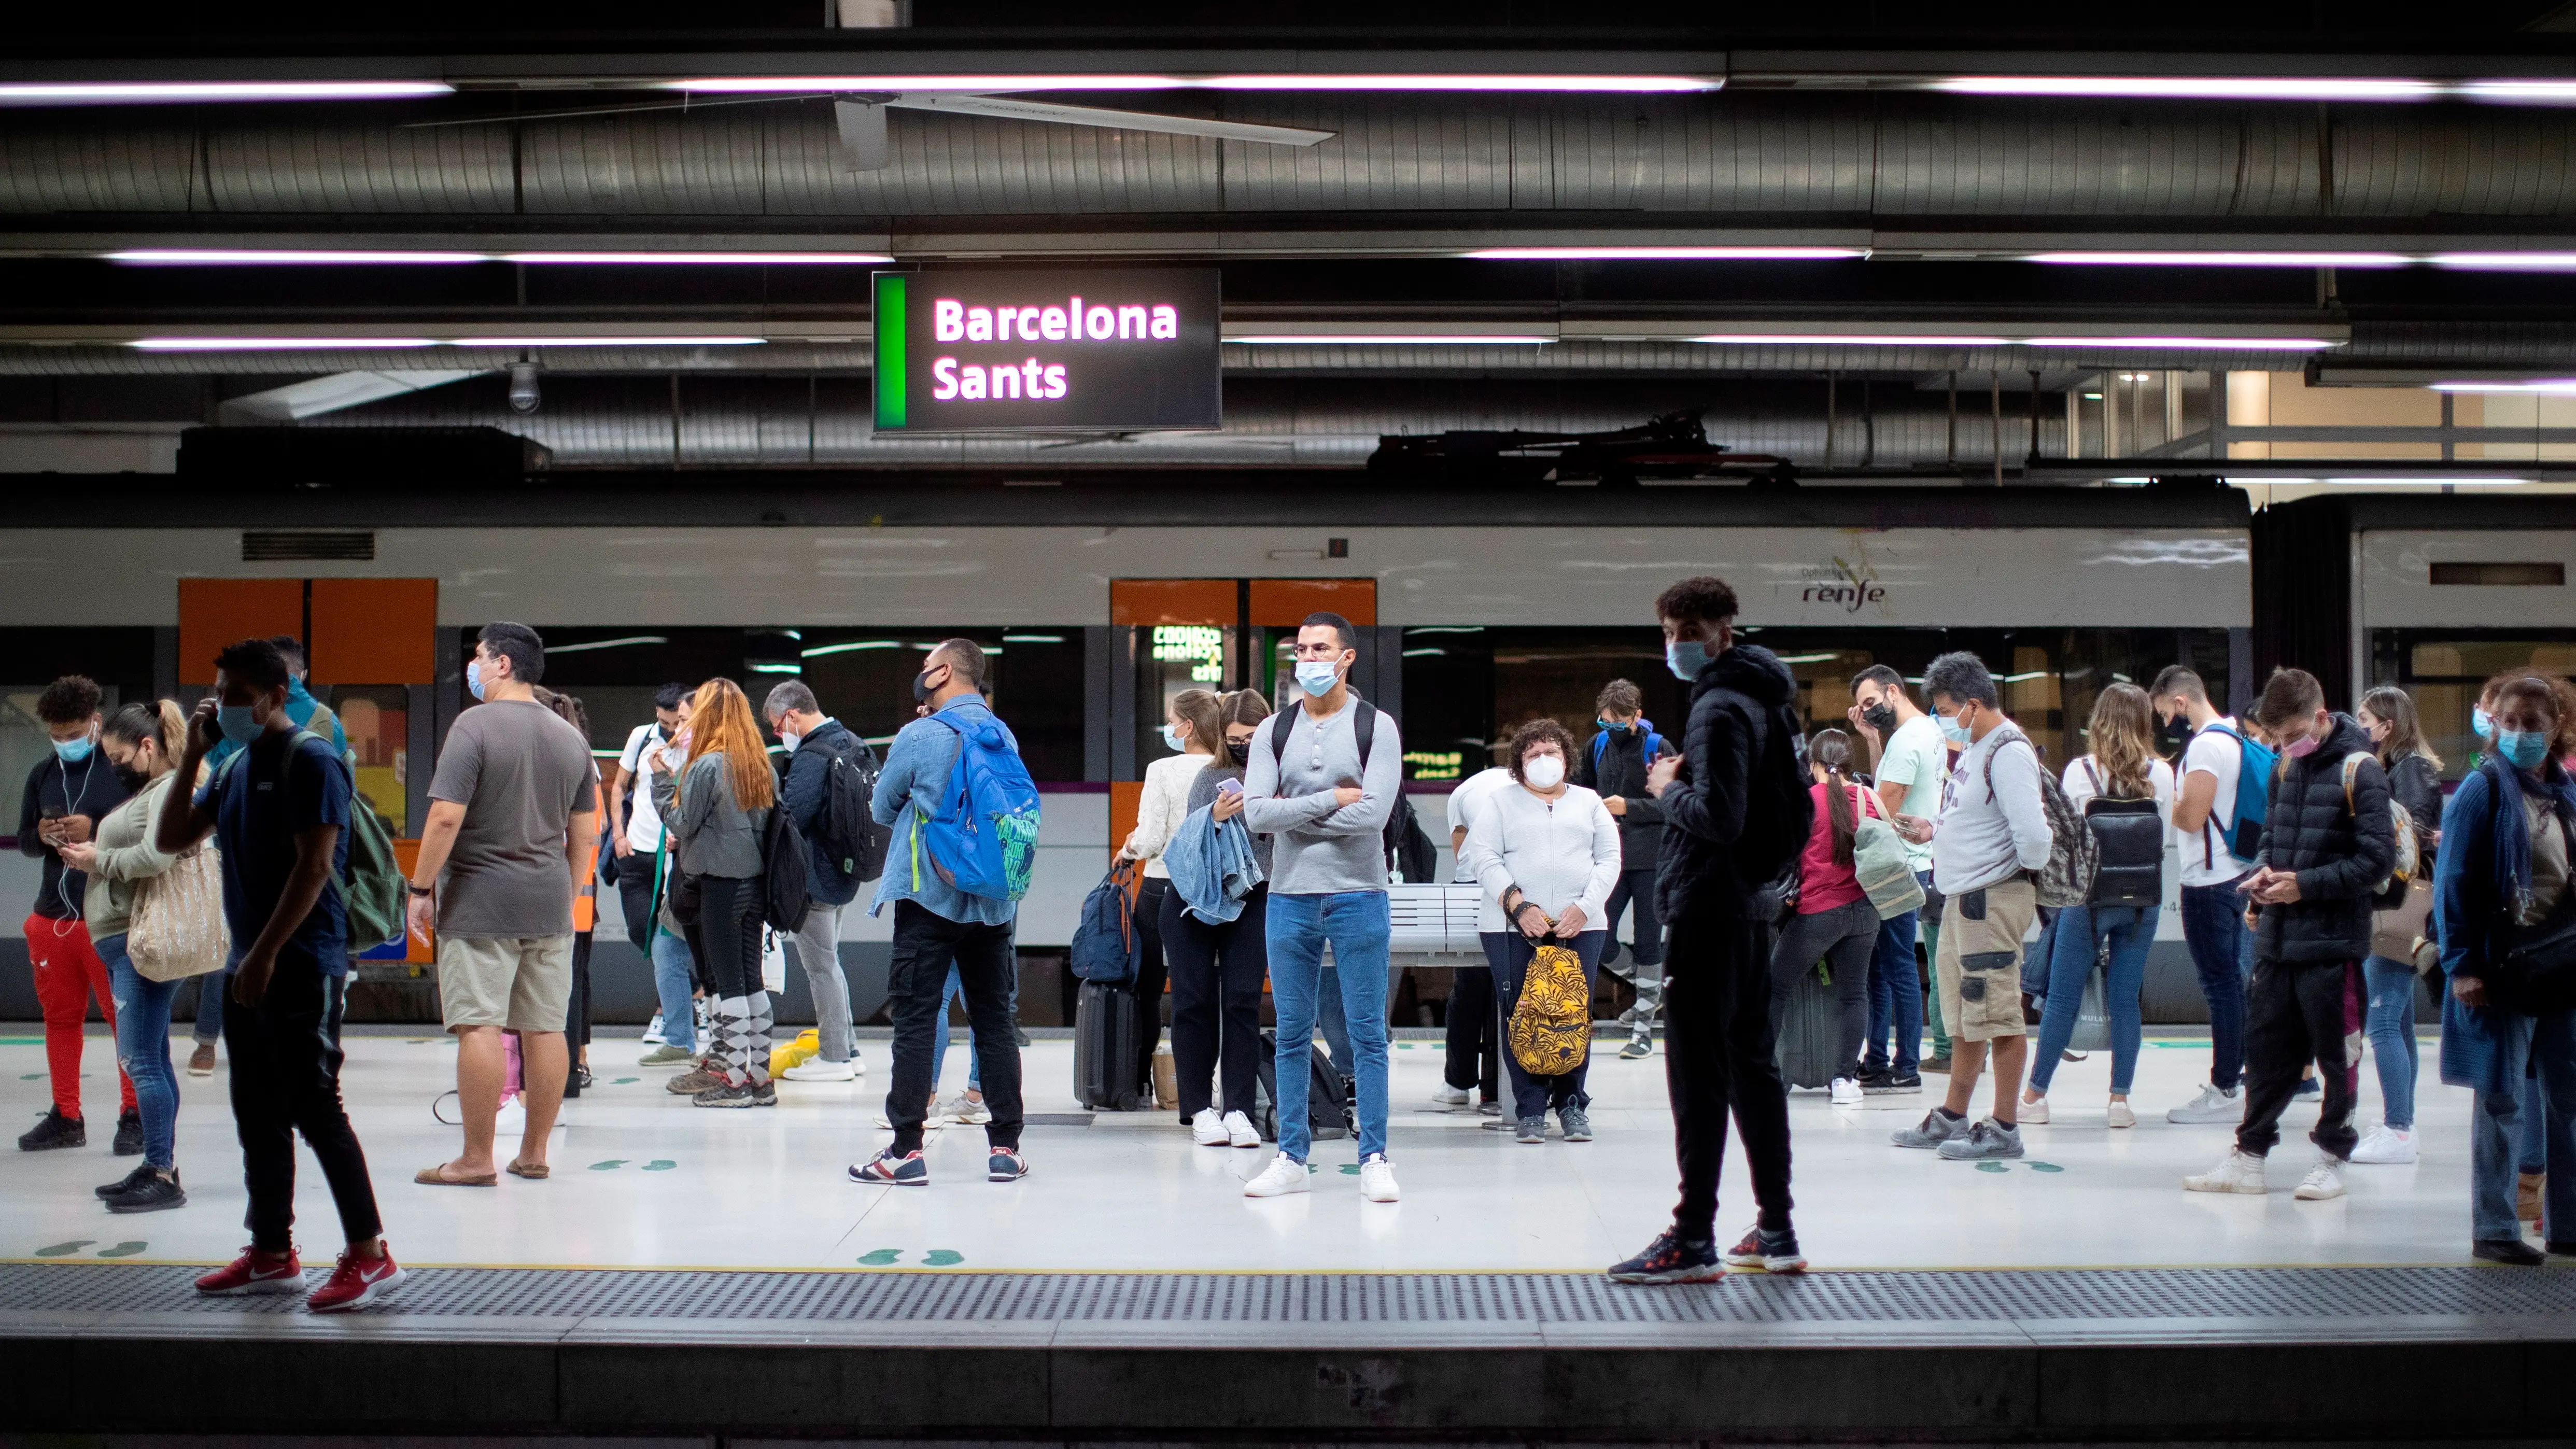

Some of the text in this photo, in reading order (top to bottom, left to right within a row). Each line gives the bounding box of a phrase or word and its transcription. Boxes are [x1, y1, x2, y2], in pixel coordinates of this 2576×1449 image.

[935, 297, 1177, 342] Barcelona
[934, 358, 1066, 400] Sants
[1802, 579, 1885, 615] renfe
